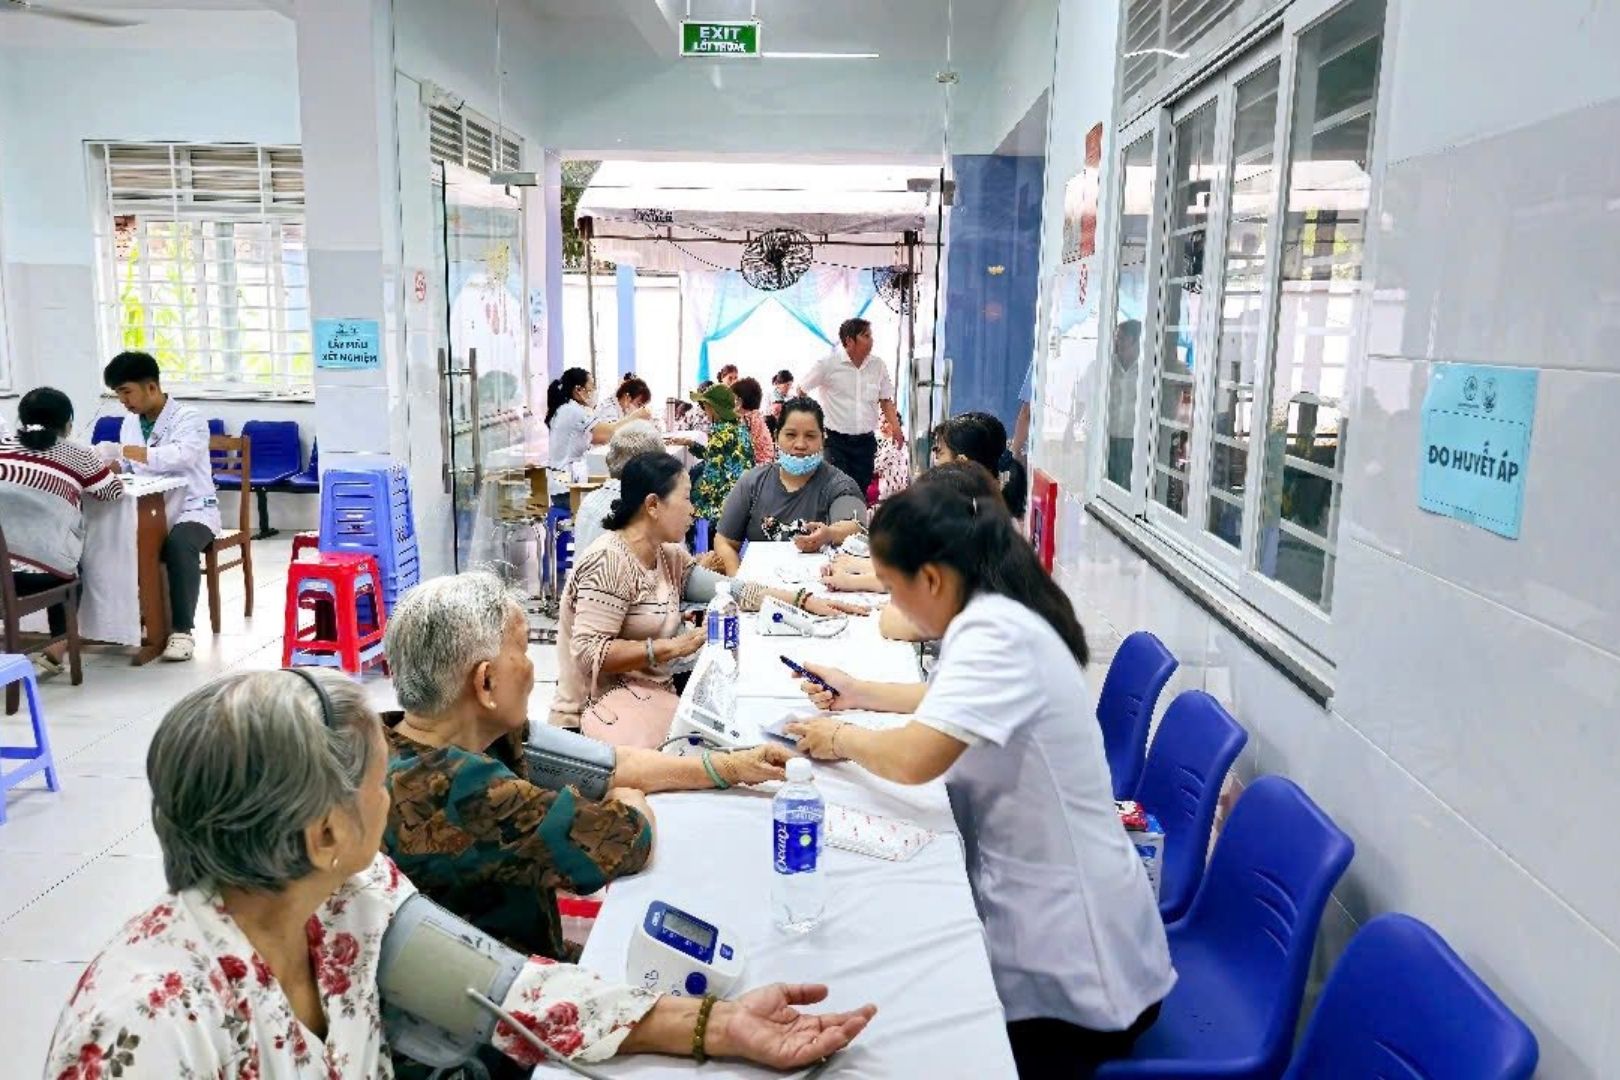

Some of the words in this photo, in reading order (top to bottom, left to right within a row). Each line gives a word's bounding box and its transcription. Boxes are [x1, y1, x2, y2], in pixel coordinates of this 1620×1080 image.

[700, 26, 741, 40] EXIT
[328, 335, 344, 349] LẤY
[346, 338, 368, 349] MẪU
[322, 350, 337, 361] XẾT
[340, 352, 377, 364] NGHIỆM
[1428, 445, 1449, 467] ĐO
[1452, 440, 1496, 478] HUYẾT
[1497, 449, 1519, 483] ÁP
